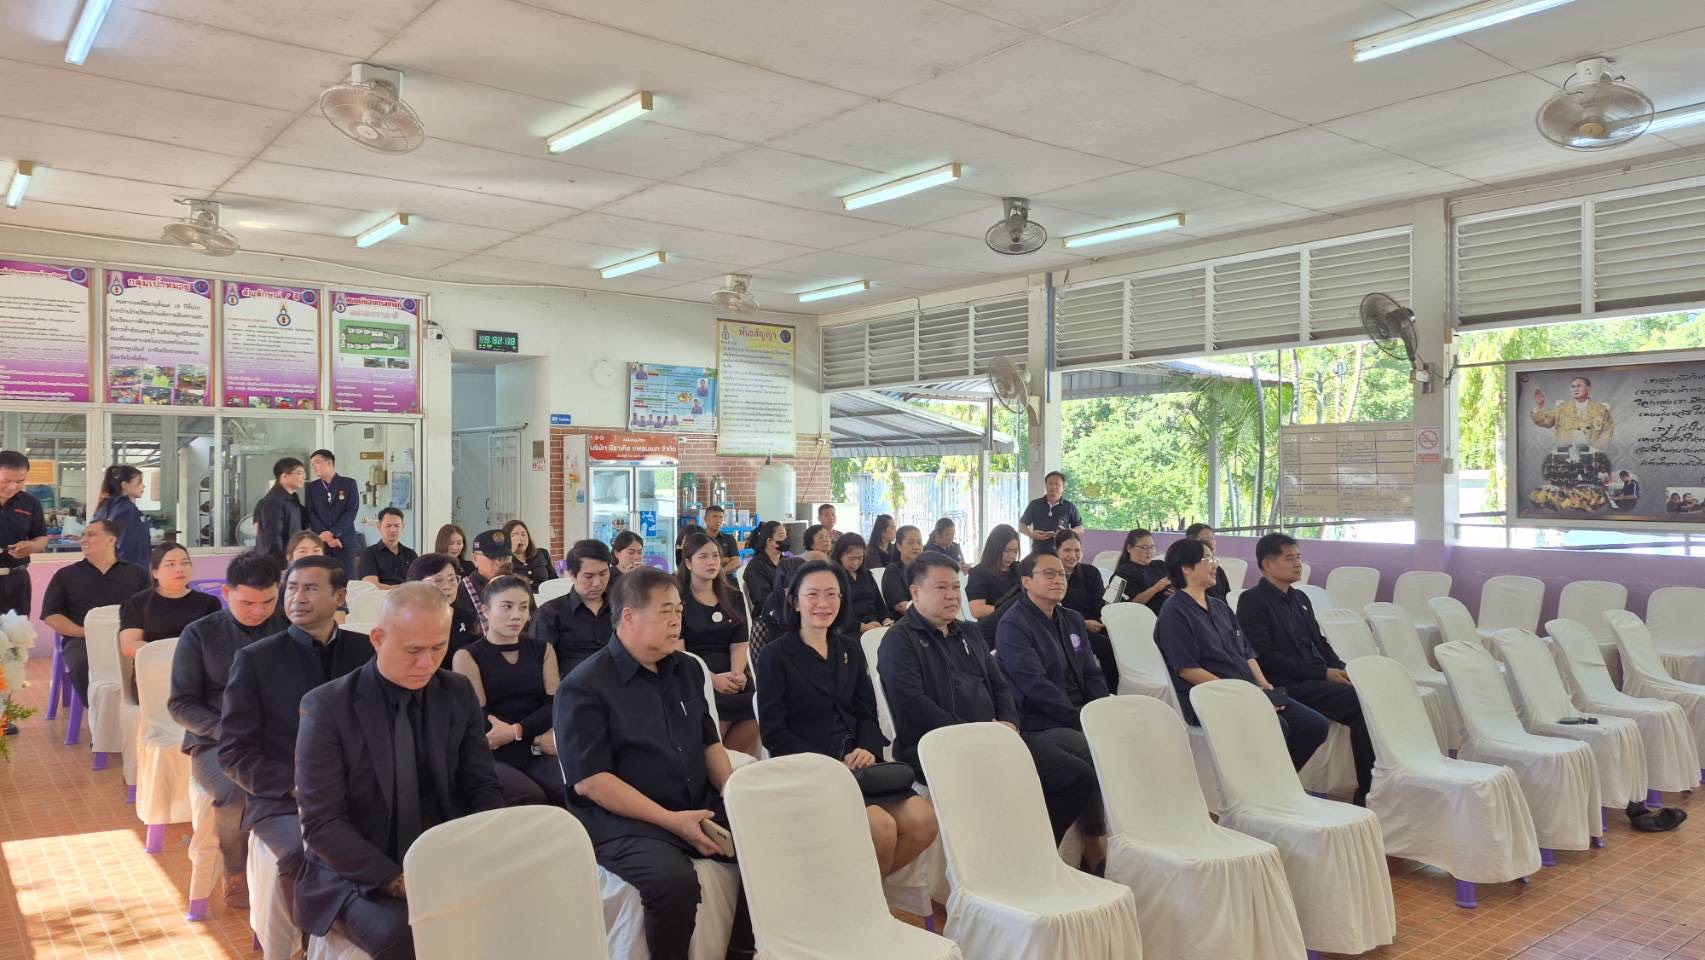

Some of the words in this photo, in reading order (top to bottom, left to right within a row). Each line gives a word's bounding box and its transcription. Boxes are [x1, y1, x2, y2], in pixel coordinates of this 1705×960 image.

[127, 276, 191, 291] กลุ่มเป้าหมาย
